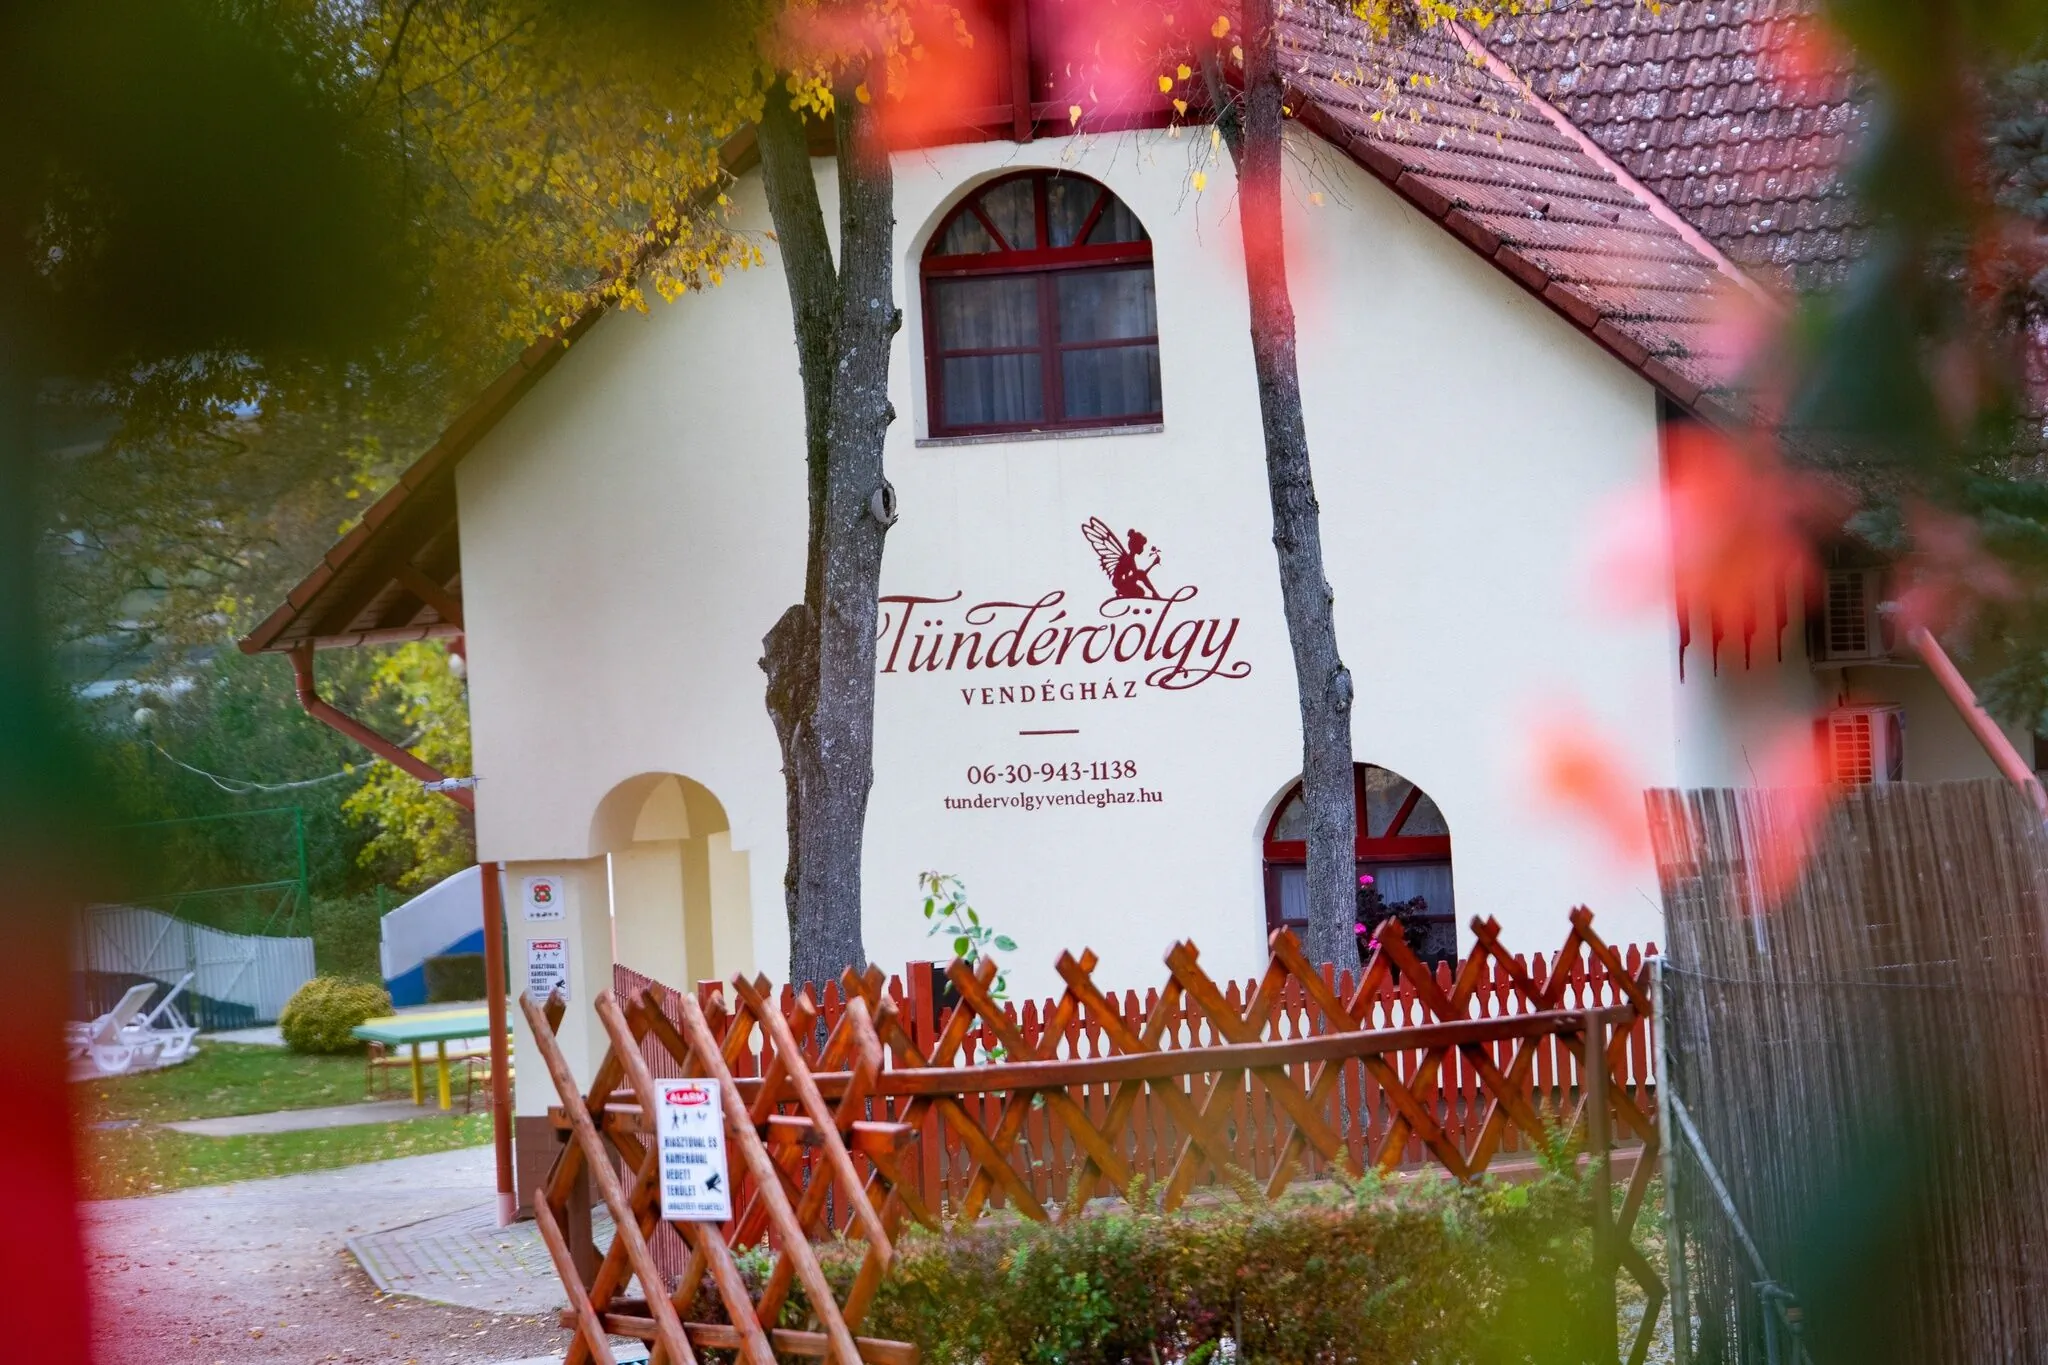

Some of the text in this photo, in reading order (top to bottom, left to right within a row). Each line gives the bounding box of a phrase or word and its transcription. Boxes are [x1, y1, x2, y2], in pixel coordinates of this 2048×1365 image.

[876, 585, 1252, 690] Tündérvölgy
[961, 678, 1137, 705] VENDÉGHÁZ
[967, 760, 1138, 785] 06-30-943-1138
[944, 787, 1163, 812] tundervolgyvendeghaz.hu
[669, 1091, 706, 1103] ALARM
